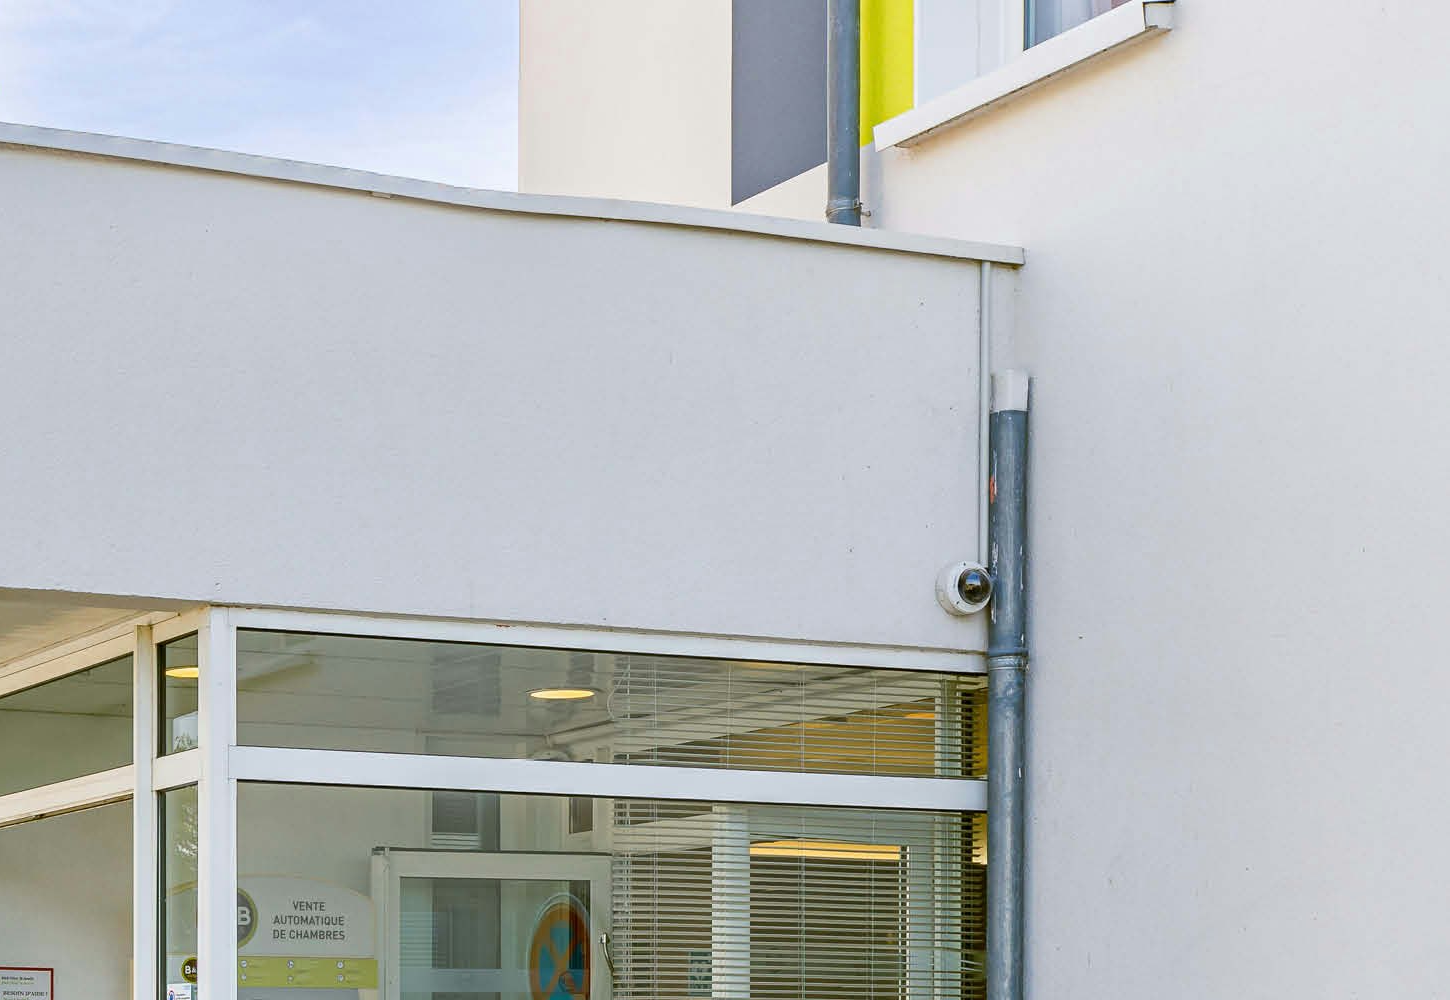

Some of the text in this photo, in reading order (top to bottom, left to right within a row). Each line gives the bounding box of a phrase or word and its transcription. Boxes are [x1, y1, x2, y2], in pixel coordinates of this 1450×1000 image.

[292, 901, 326, 912] VENTE
[273, 915, 345, 926] AUTOMATIQUE
[272, 929, 345, 941] DE CHAMBRES
